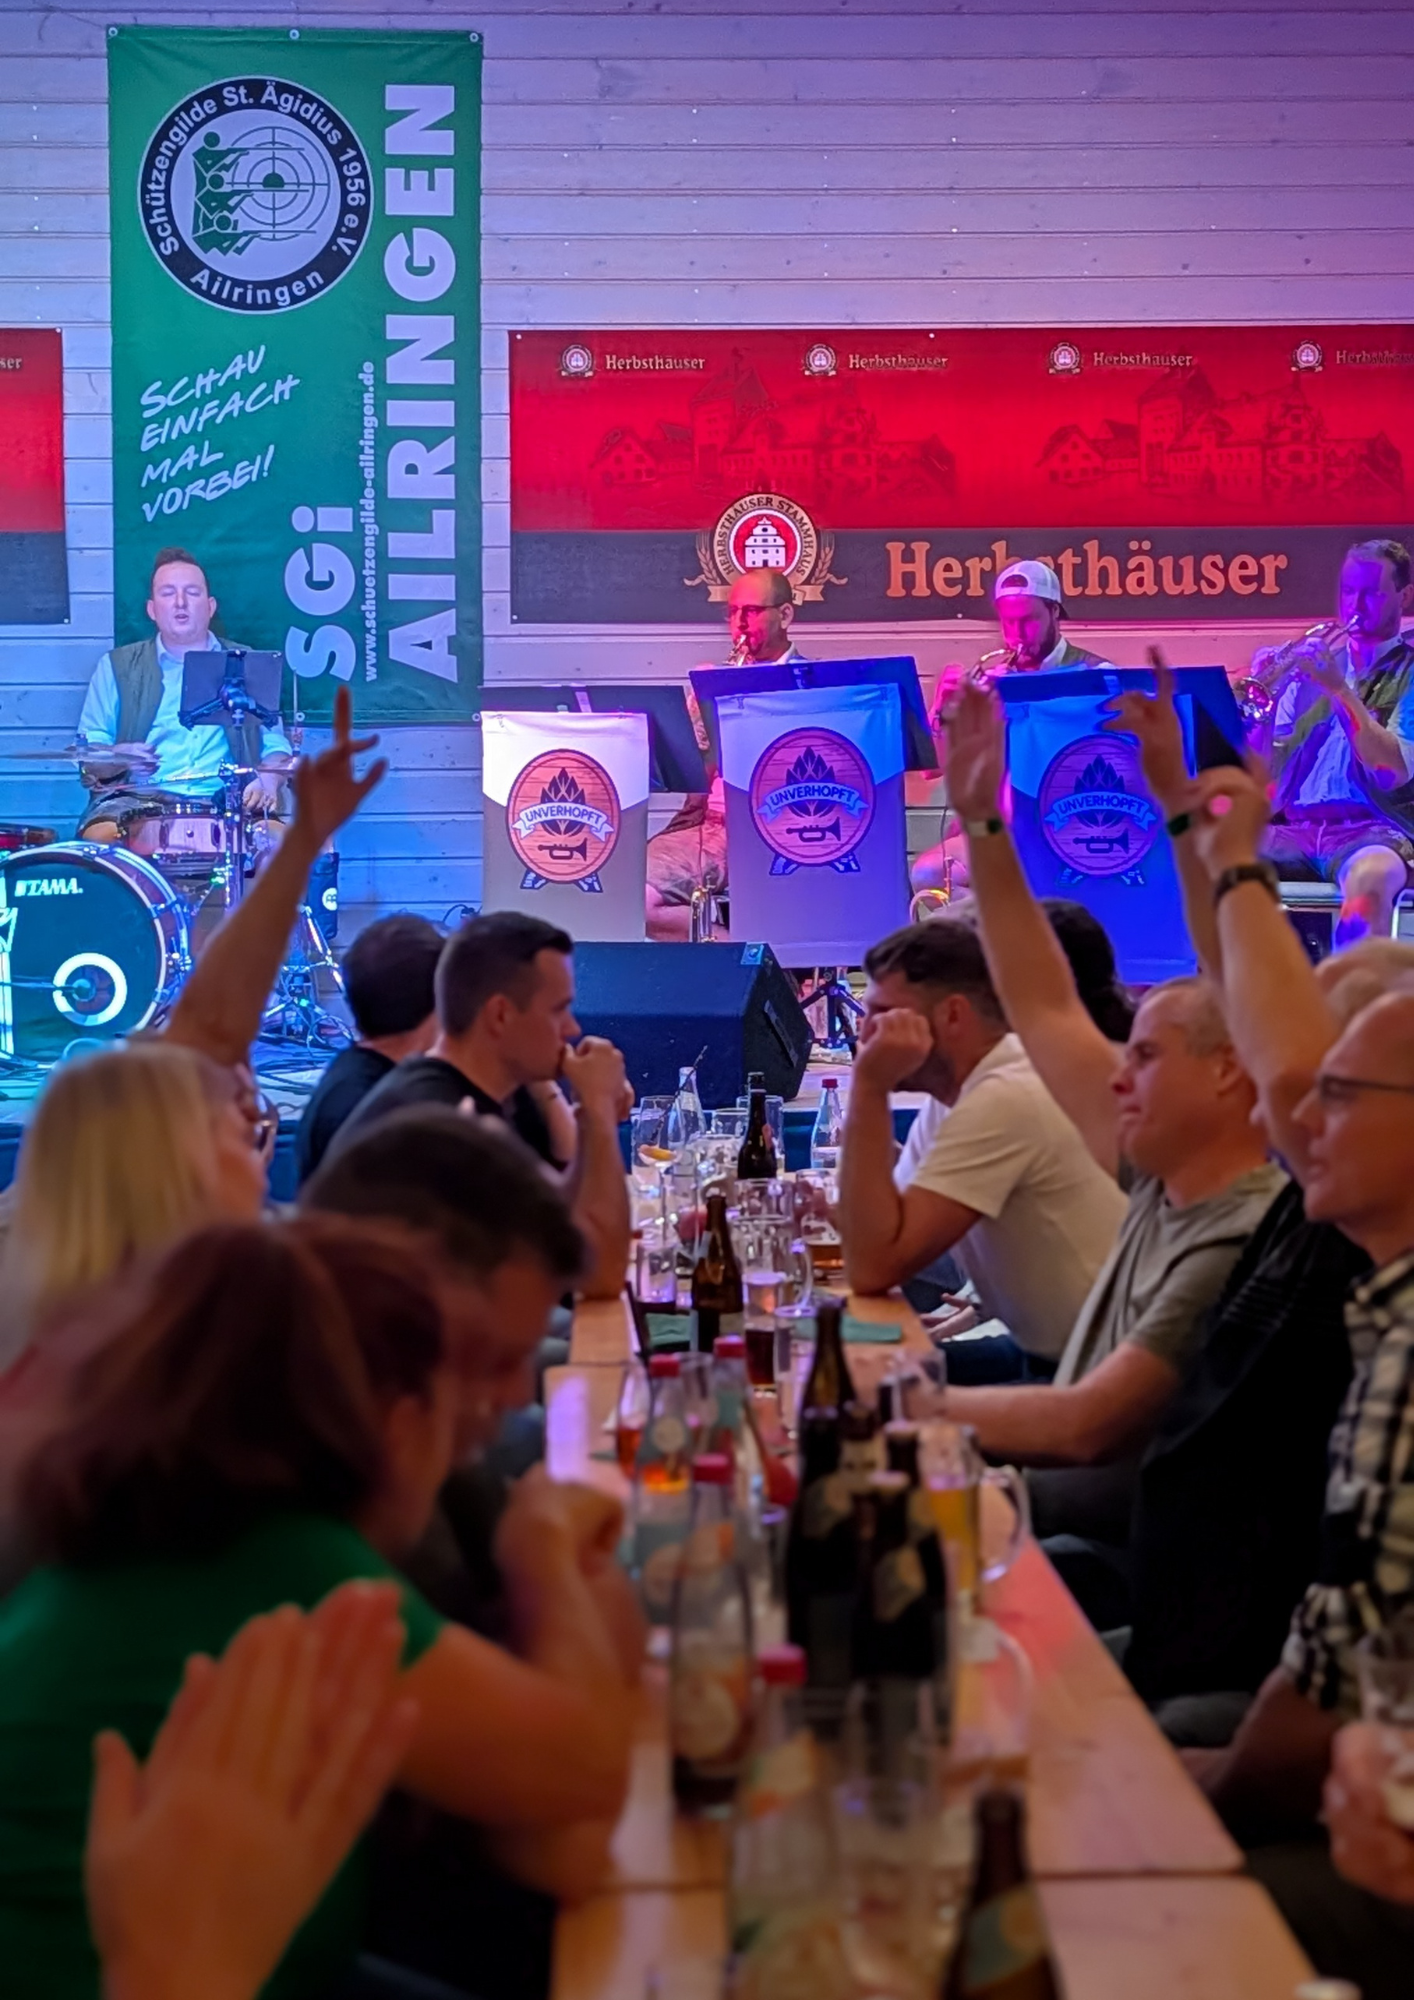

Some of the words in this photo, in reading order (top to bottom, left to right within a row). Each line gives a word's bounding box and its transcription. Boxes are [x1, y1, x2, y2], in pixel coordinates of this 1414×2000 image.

[222, 85, 254, 107] St.
[260, 81, 342, 145] Ägidius
[145, 98, 218, 256] Schützengilde
[339, 147, 367, 207] 1956
[332, 213, 359, 255] e.V.
[190, 269, 324, 306] Ailringen
[140, 344, 266, 418] SCHAU
[384, 84, 458, 683] AILRINGEN
[140, 374, 300, 452] EINFACH
[141, 440, 224, 488] MAL
[141, 444, 275, 522] VORBEI!
[358, 361, 379, 683] www.schuetzengilde-ailringen.de
[777, 500, 814, 576] STAMMHAUS
[524, 806, 603, 828] UNVERHOPFT
[770, 783, 856, 806] UNVERHOPFT
[1058, 794, 1146, 815] UNVERHOPFT
[27, 877, 78, 896] TAMA
